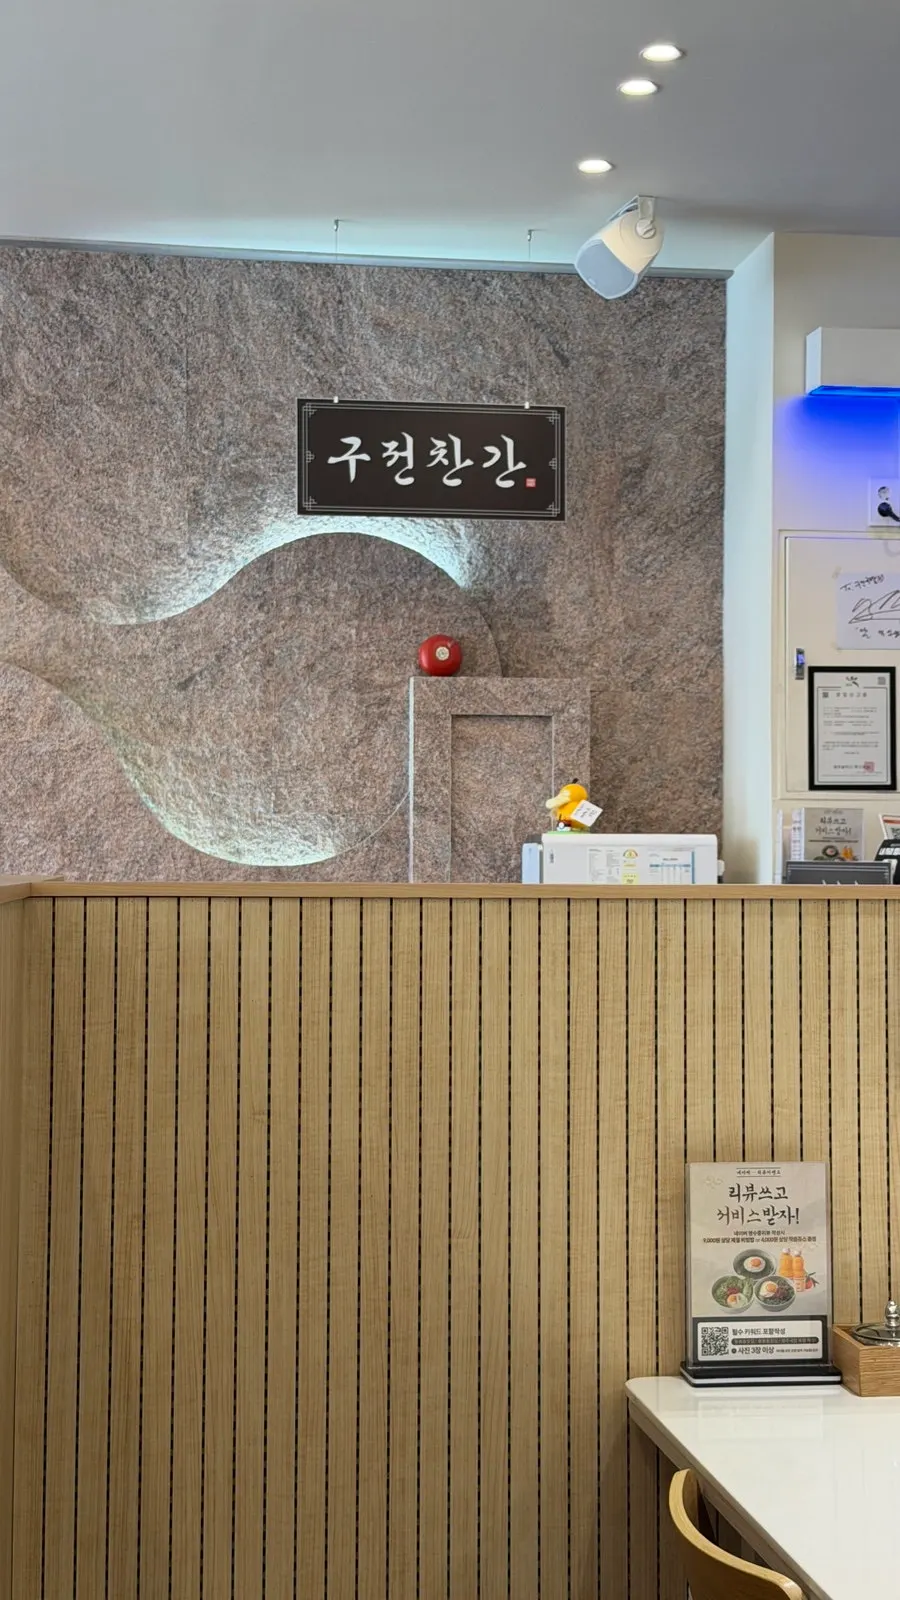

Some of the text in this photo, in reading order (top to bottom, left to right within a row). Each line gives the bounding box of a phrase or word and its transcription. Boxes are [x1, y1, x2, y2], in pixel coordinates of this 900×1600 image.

[729, 1183, 788, 1202] 리뷰쓰고
[717, 1205, 799, 1225] 서비스받자!
[732, 1328, 744, 1336] 필수
[744, 1328, 761, 1336] 키워드
[762, 1346, 774, 1354] 이상
